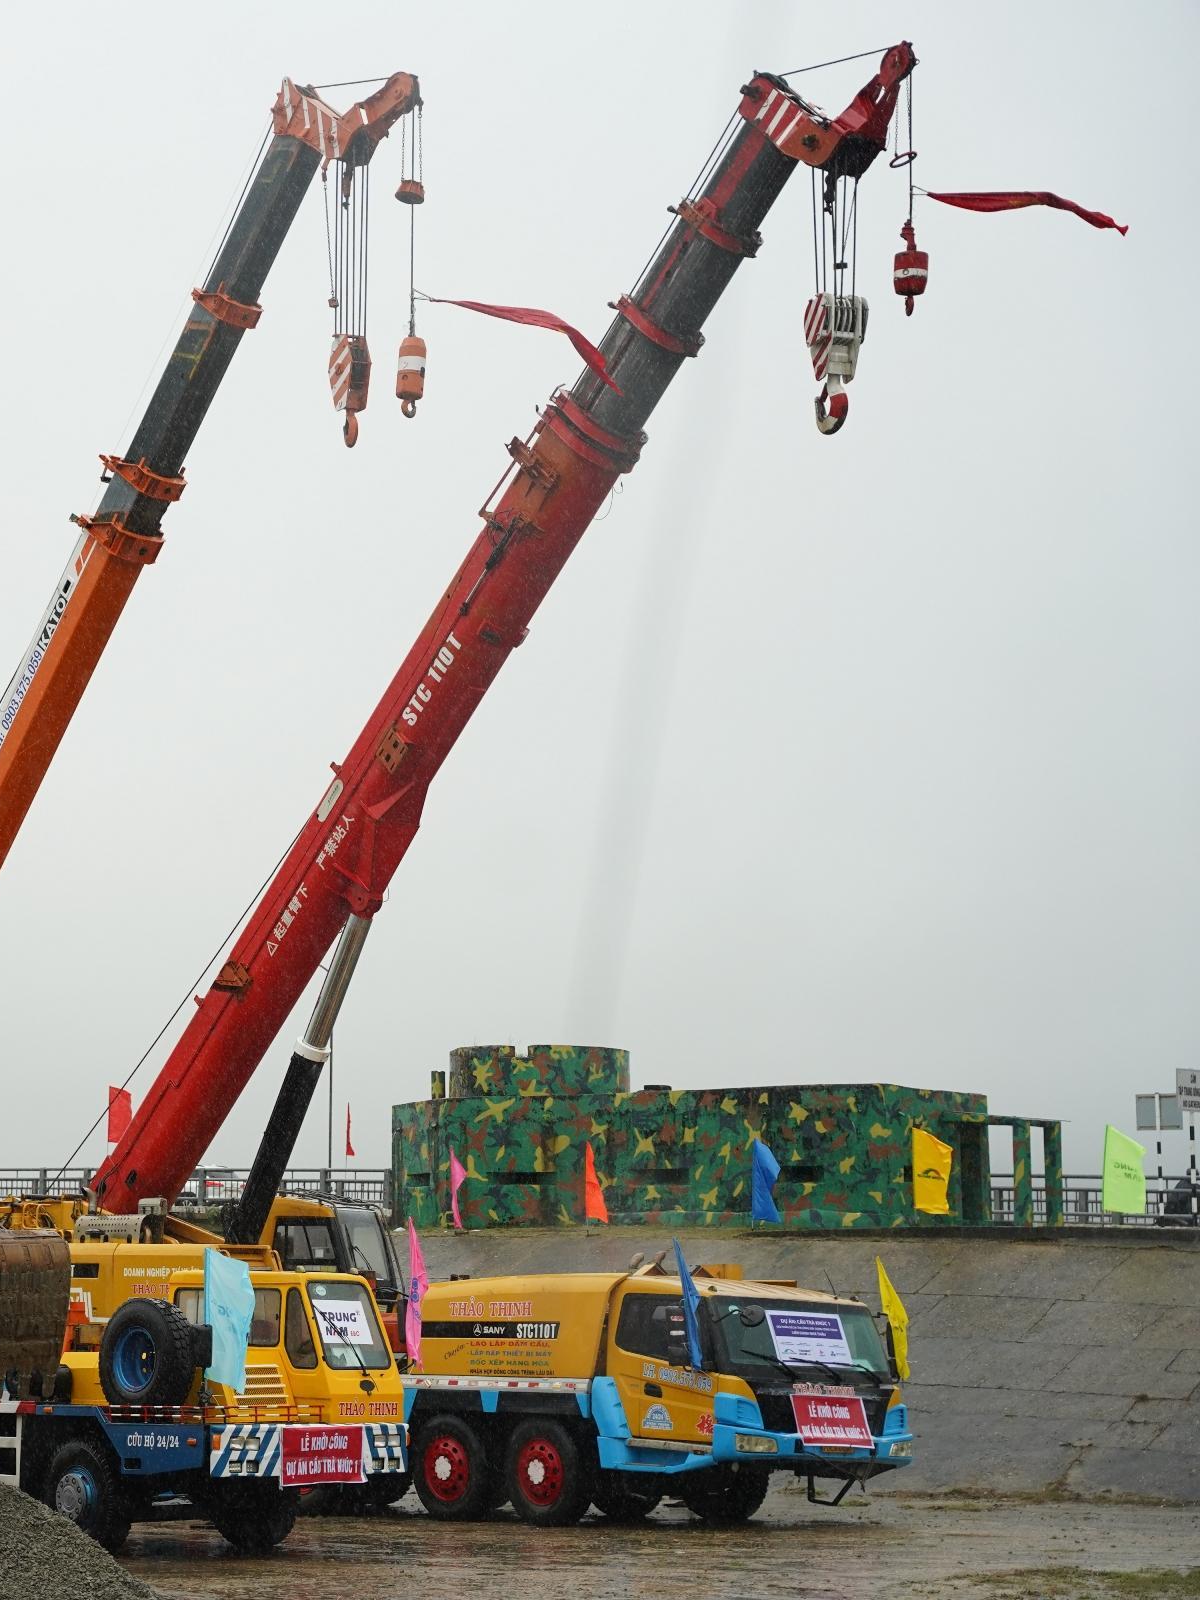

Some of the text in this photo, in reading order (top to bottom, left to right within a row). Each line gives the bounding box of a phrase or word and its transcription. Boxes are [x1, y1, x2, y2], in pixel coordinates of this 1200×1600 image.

[37, 593, 68, 652] KATO
[1, 650, 43, 731] 0903.575.059
[402, 683, 432, 727] STC
[315, 815, 355, 871] 严禁站人
[123, 1267, 145, 1277] DOANH
[146, 1265, 171, 1280] NGHIỆP
[321, 1311, 357, 1323] TRUNG
[448, 1295, 533, 1321] THẢO THỊNH
[325, 1326, 349, 1337] NAM
[483, 1323, 557, 1339] SANY STC110T
[338, 1397, 399, 1418] THẢO THỊNH
[808, 1400, 851, 1420] LỄ KHỞI CÔNG
[143, 1431, 155, 1450] HỘ
[156, 1435, 180, 1450] 24/24
[300, 1431, 349, 1452] LỄ KHỞI CÔNG
[861, 1427, 868, 1440] 1
[286, 1459, 296, 1479] DỰ
[297, 1457, 309, 1476] ÁN
[354, 1460, 359, 1474] 1
